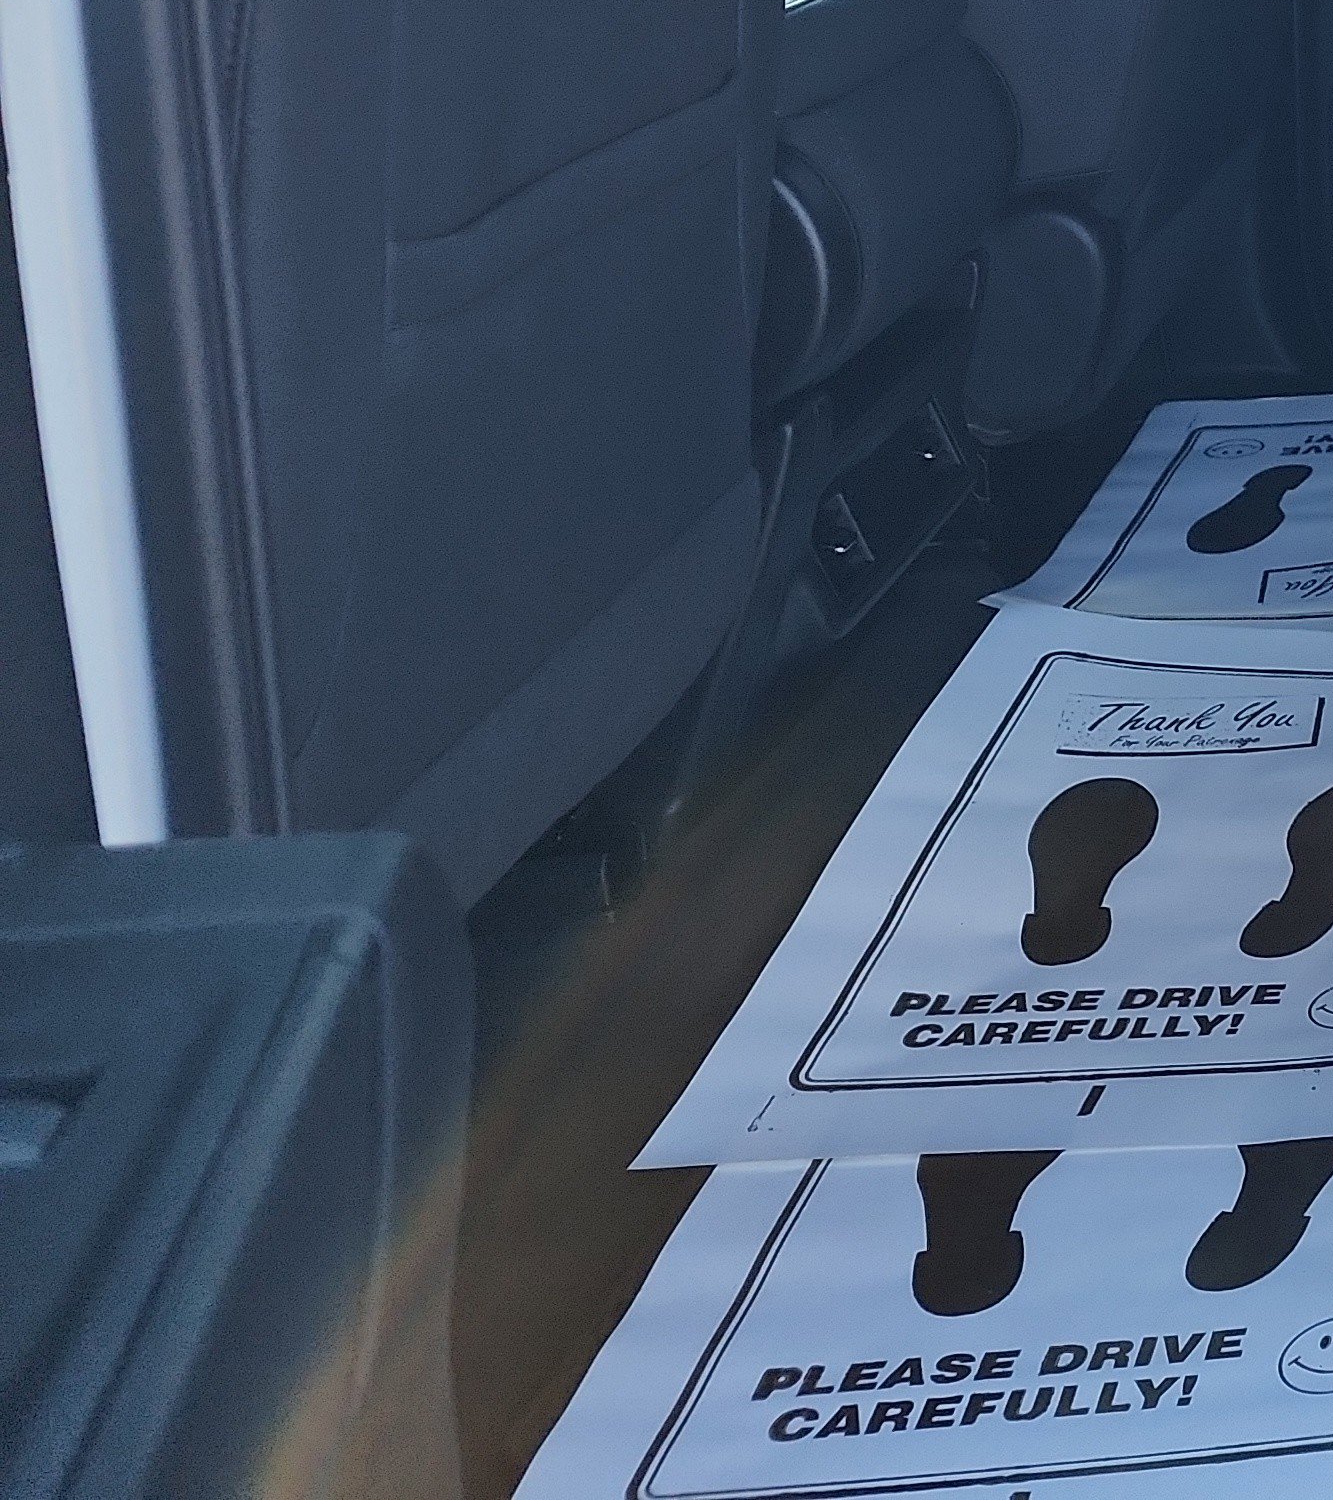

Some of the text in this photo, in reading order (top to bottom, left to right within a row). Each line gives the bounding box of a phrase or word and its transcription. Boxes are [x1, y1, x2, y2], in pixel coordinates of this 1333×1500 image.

[1087, 700, 1296, 732] Thank You
[889, 983, 1287, 1018] PLEASE DRIVE
[902, 1013, 1245, 1049] CAREFULLY!
[751, 1327, 1248, 1401] PLEASE DRIVE
[767, 1373, 1199, 1443] CAREFULLY!
